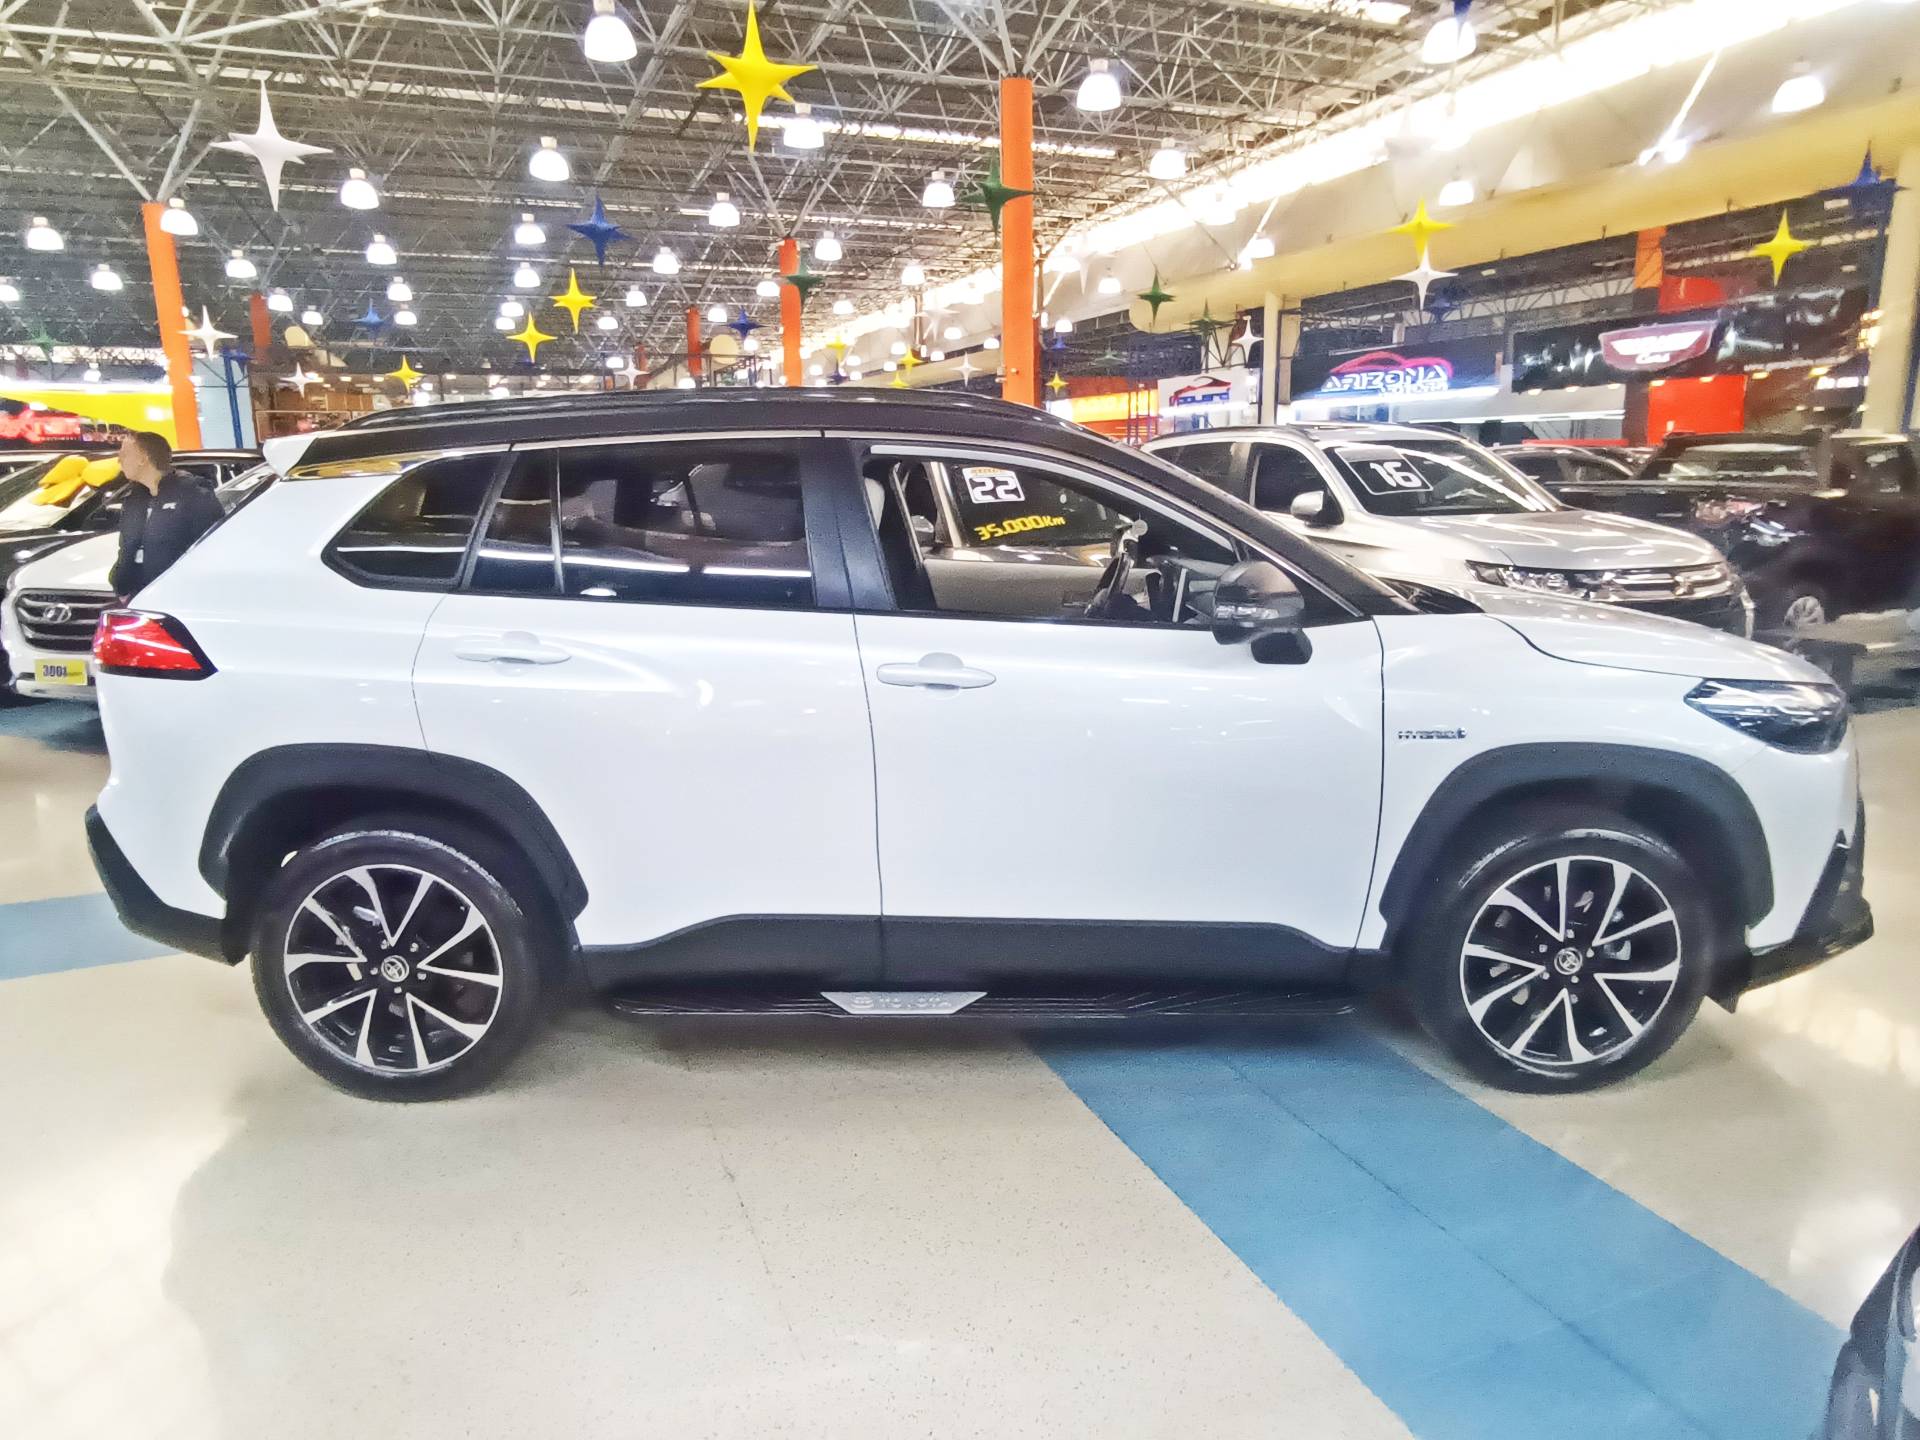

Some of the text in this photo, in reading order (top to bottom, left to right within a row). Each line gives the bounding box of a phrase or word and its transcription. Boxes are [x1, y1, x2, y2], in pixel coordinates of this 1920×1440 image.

[1321, 365, 1448, 392] ARIZONA
[1369, 461, 1422, 488] 16
[972, 476, 1018, 501] 22
